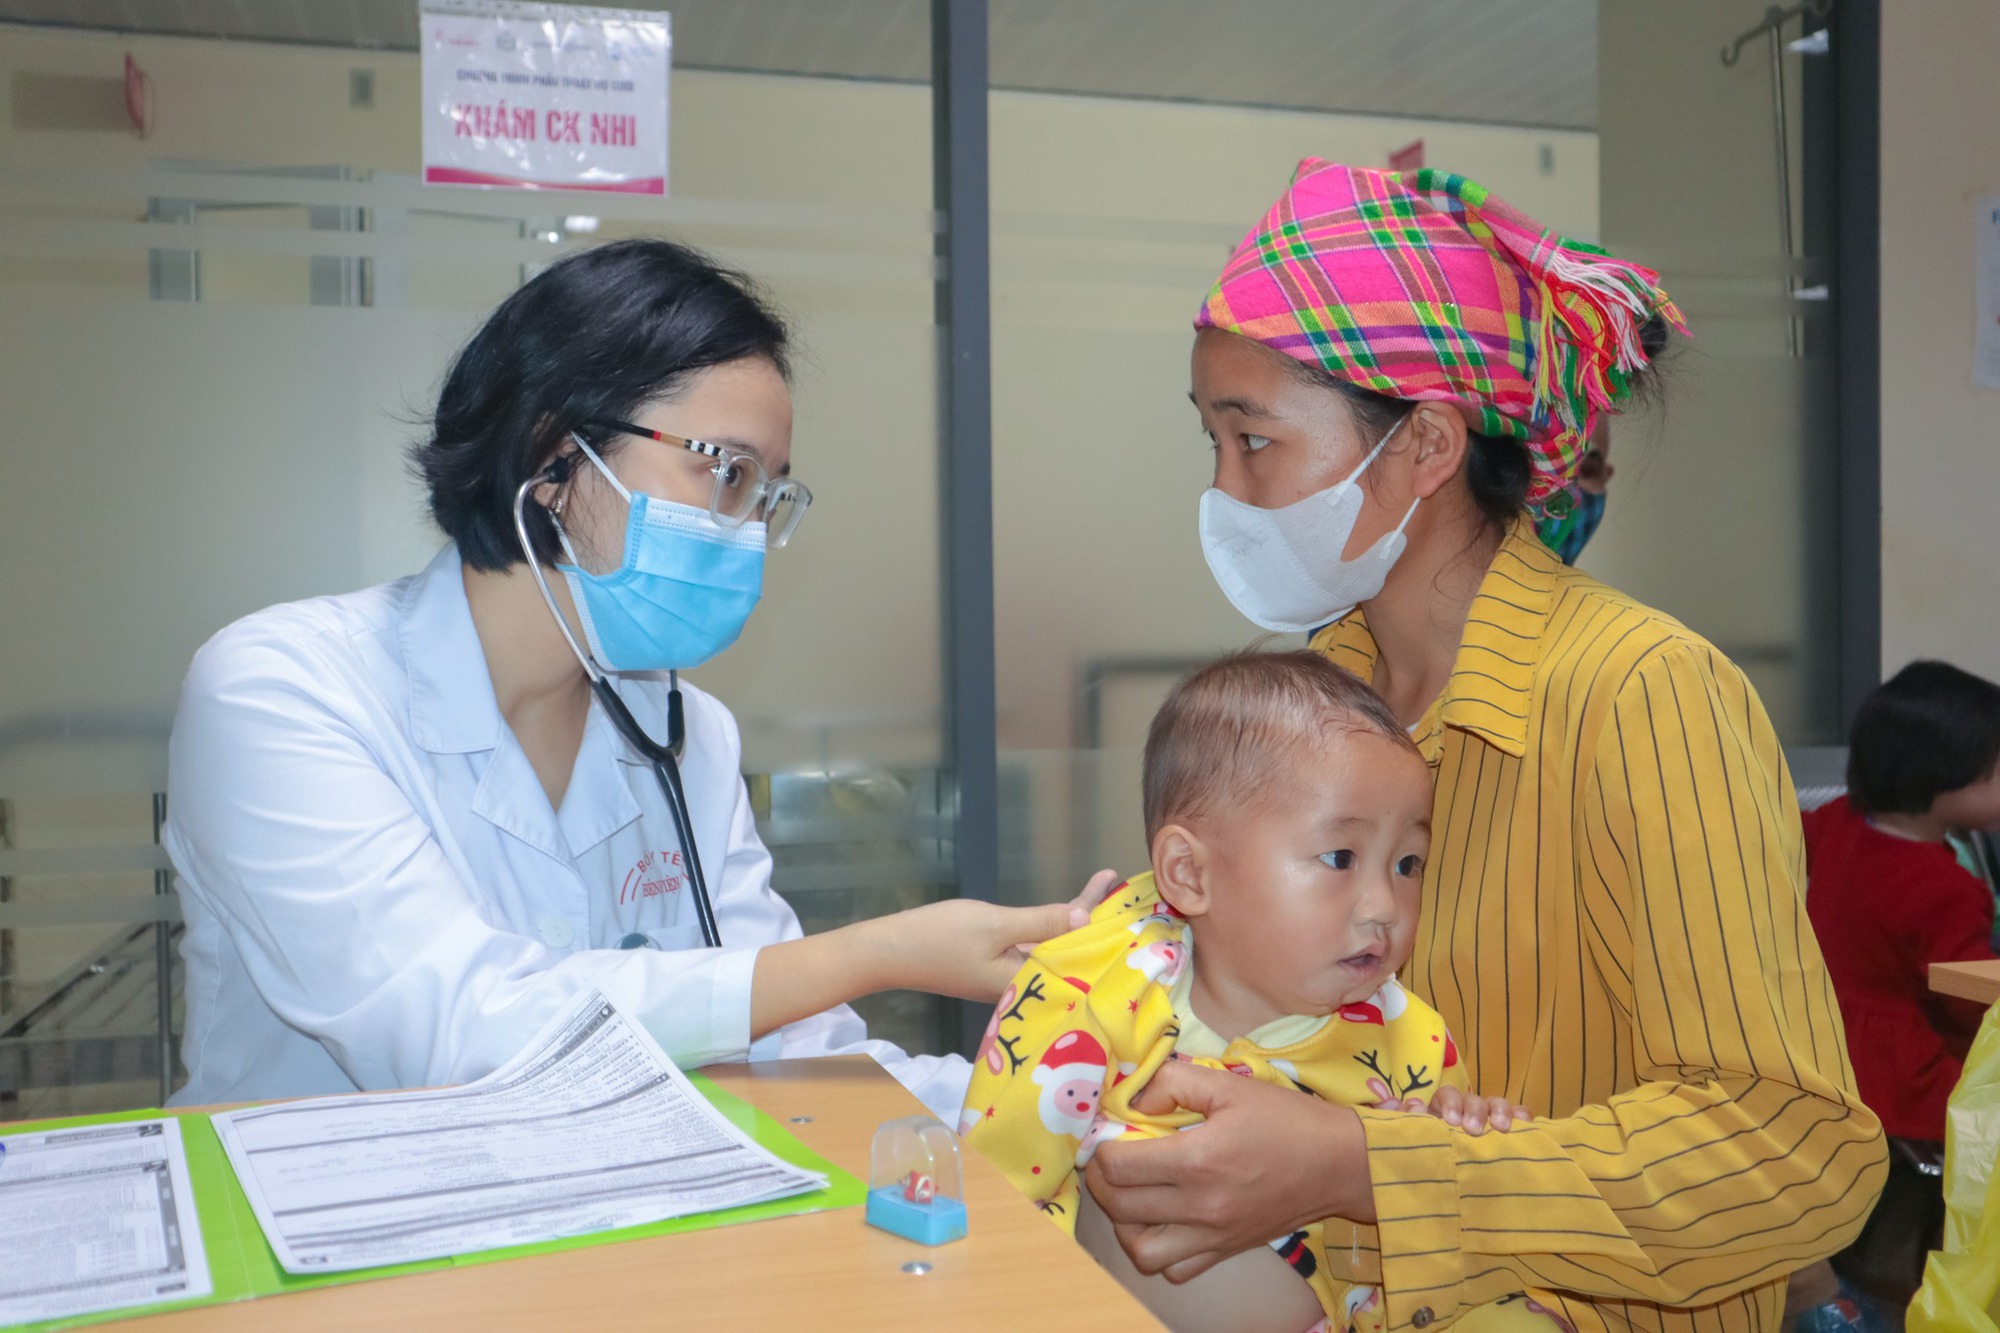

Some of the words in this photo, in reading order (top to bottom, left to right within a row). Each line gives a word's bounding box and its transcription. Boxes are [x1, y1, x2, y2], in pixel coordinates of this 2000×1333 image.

[455, 98, 537, 140] KHÁM
[546, 108, 582, 144] CK
[590, 112, 636, 147] NHI
[587, 1016, 602, 1031] LAB
